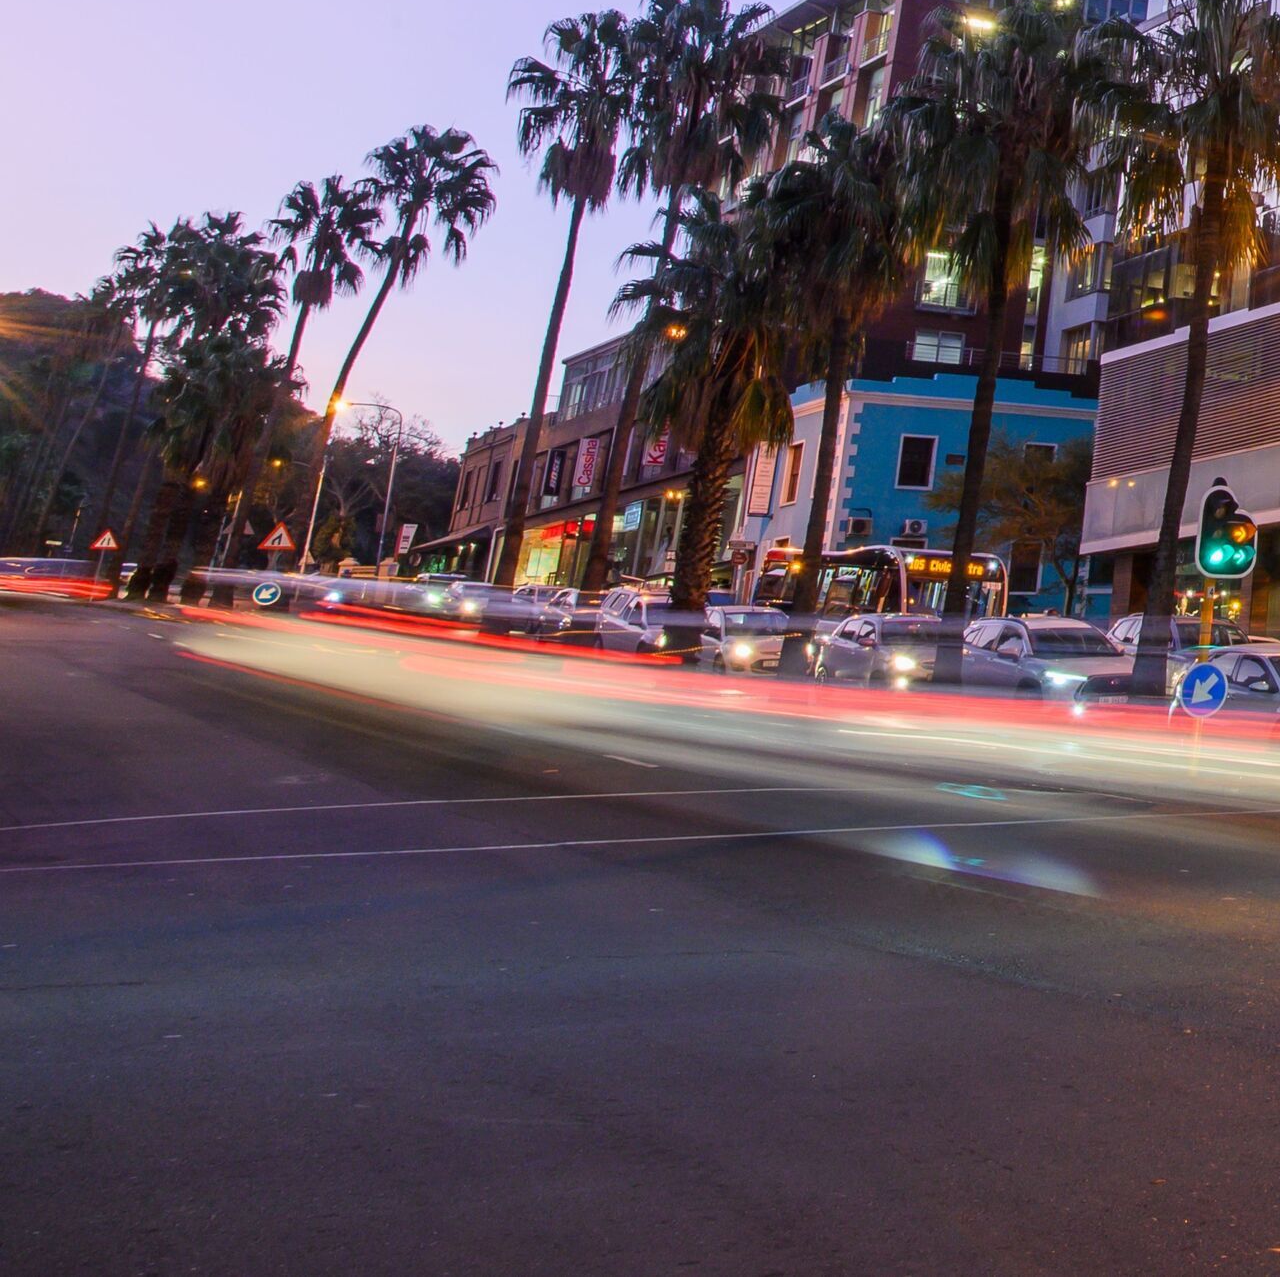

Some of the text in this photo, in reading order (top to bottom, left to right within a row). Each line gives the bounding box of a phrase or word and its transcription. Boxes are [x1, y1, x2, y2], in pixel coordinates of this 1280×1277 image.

[577, 439, 598, 486] Cassina
[908, 559, 926, 571] 105
[929, 560, 952, 573] Civic
